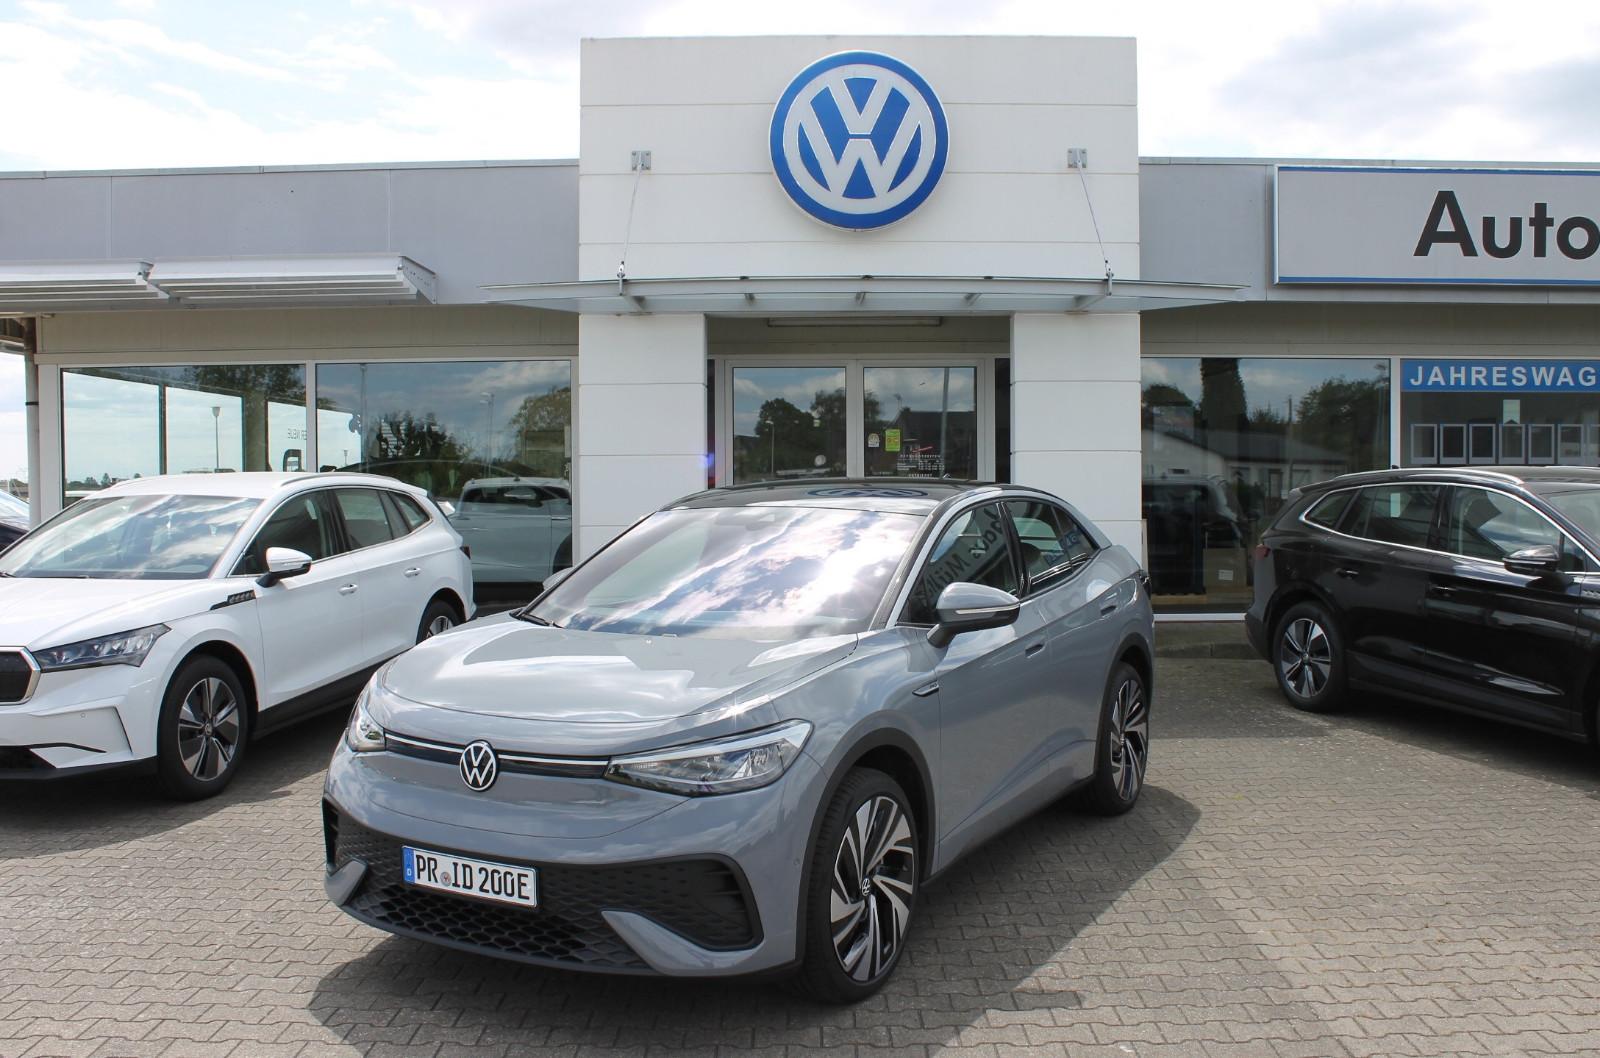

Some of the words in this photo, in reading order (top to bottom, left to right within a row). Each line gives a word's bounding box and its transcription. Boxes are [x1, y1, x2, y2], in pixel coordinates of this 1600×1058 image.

[783, 64, 936, 214] VW
[1413, 190, 1600, 260] Auto
[1410, 366, 1597, 387] JAHRESWAG
[460, 741, 496, 791] VW
[415, 854, 438, 883] PR
[451, 861, 474, 890] ID
[478, 867, 530, 900] 200E
